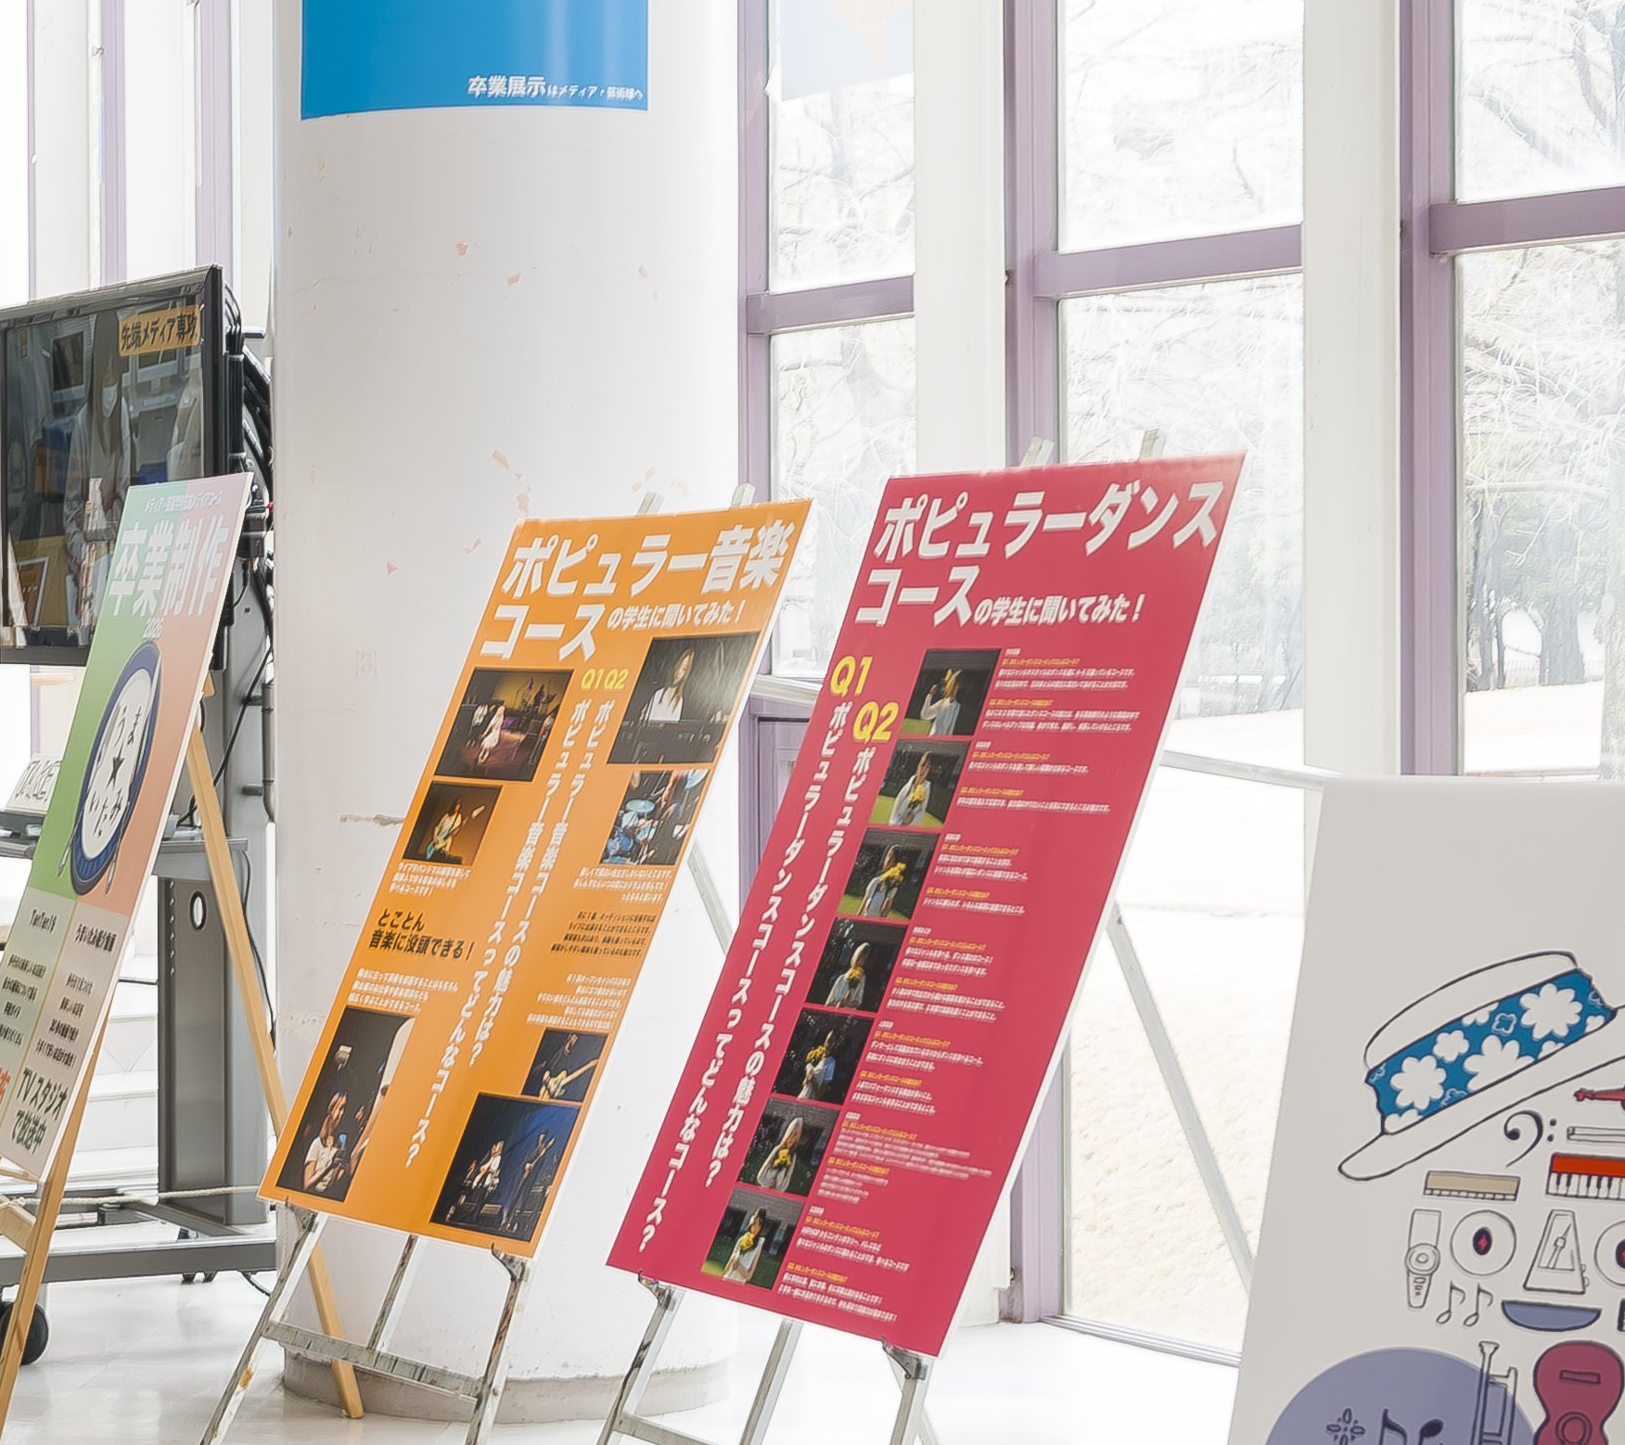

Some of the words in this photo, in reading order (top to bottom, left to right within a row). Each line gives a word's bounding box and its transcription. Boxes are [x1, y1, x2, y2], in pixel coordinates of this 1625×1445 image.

[120, 313, 199, 350] 先端メディア専攻
[873, 478, 1226, 564] ポピュラーダンス
[106, 514, 230, 619] 卒業制作
[500, 519, 796, 600] ポピュラー音楽
[854, 564, 1147, 628] コースの学生に聞いてみた！
[479, 599, 748, 662] コースの学生に聞いてみた！
[580, 667, 603, 691] Q1
[603, 667, 630, 691] Q2
[829, 654, 874, 698] Q1
[852, 701, 901, 743] Q2
[468, 698, 617, 1068] ポピュラー音楽コースの魅力は？
[368, 927, 476, 961] 音楽に没頭できる！
[377, 908, 426, 932] とことん
[404, 697, 593, 1169] ポピュラー音楽コースってどんなコース？
[637, 701, 852, 1254] ポピュラーダンスコースってどんなコース？
[705, 746, 877, 1189] ポピュラーダンスコースの魅力は？
[15, 1066, 69, 1123] TVスタジオ
[11, 1109, 47, 1155] で放送中
